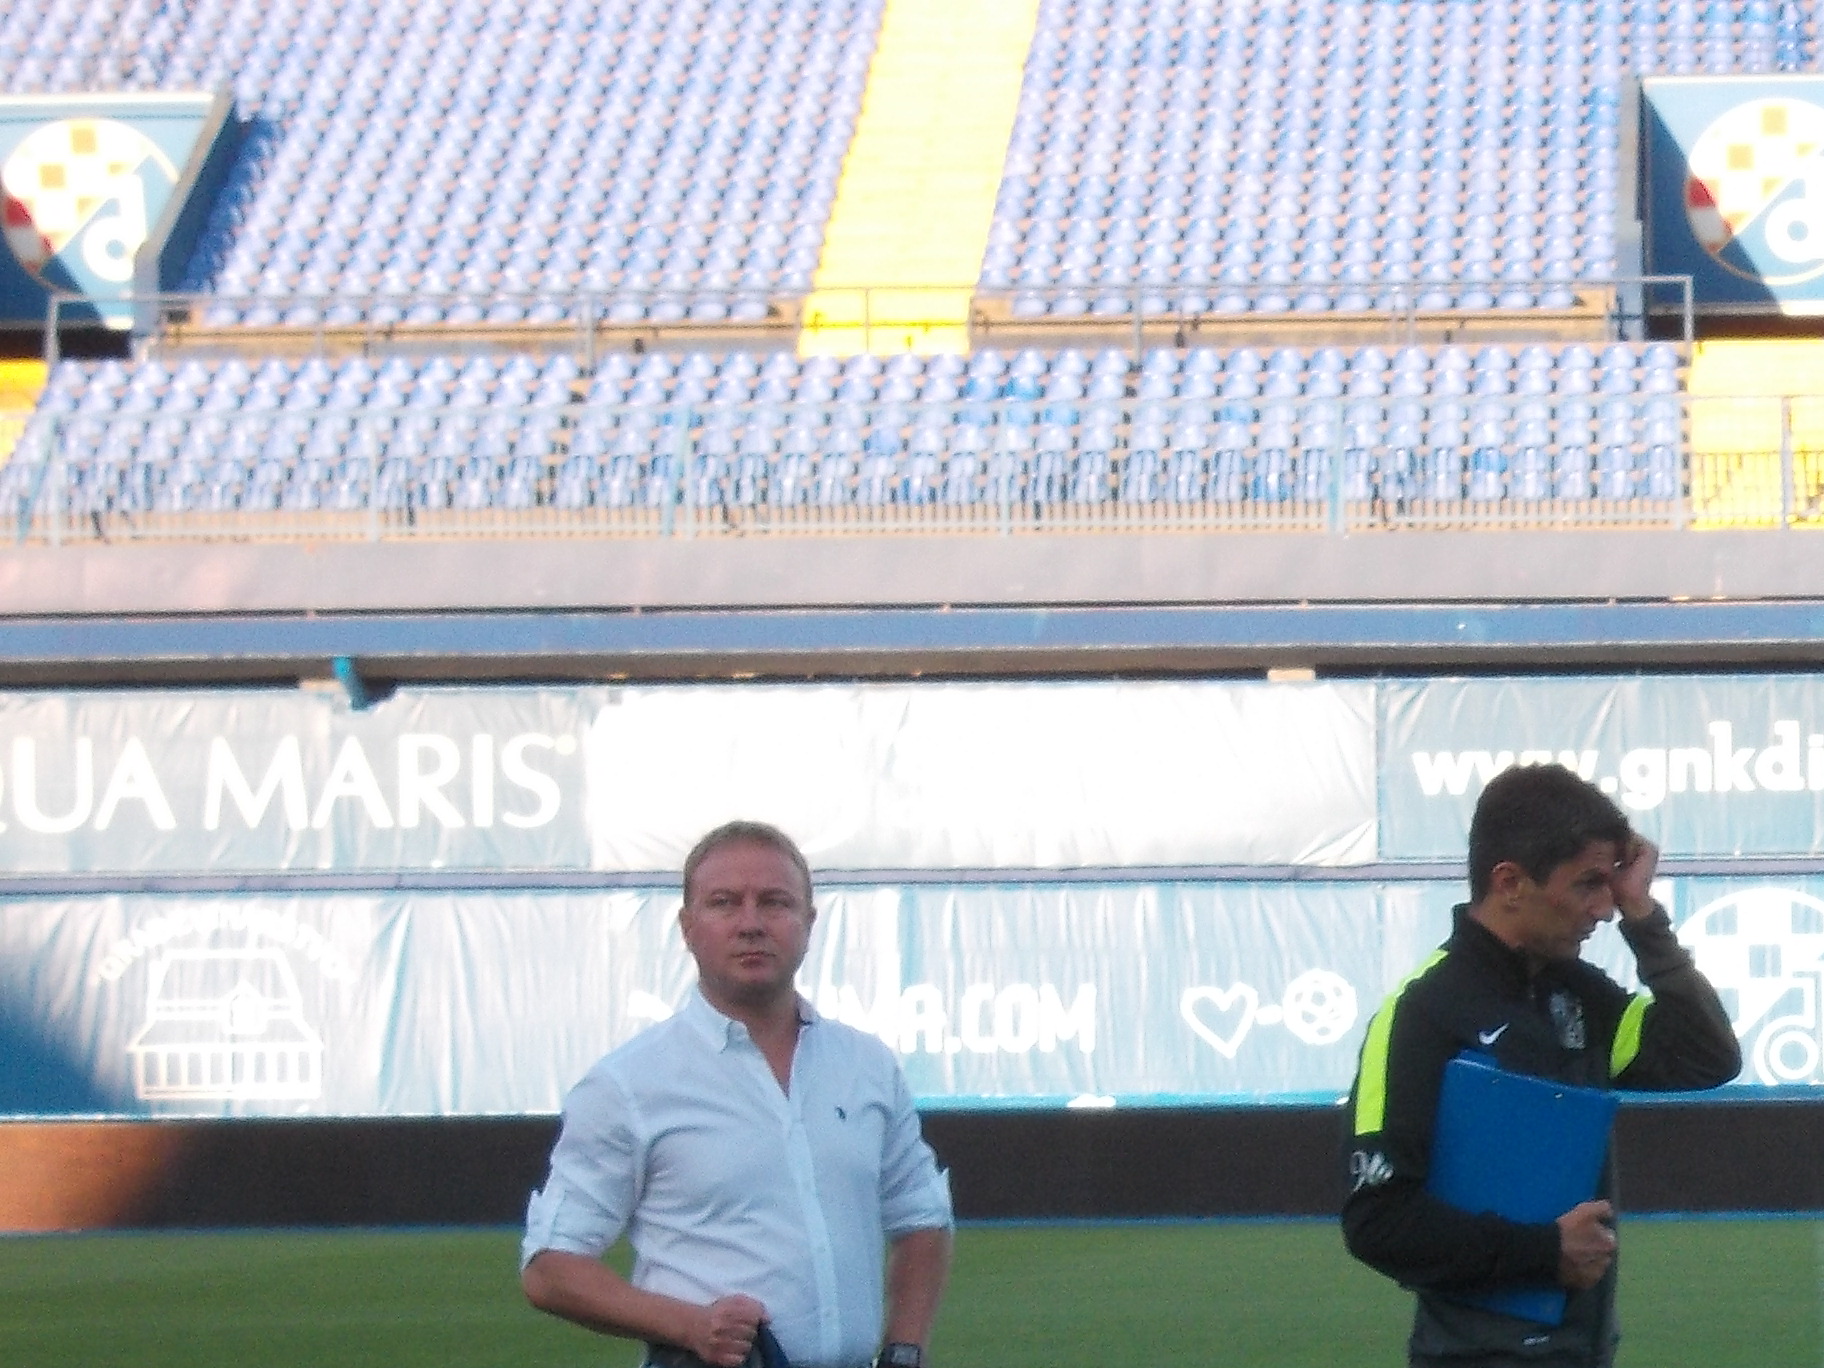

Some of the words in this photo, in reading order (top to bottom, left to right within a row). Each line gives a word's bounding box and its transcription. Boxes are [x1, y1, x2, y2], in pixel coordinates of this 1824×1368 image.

[0, 735, 177, 834] UA
[204, 734, 563, 831] MARIS
[796, 980, 1098, 1055] MA.COM
